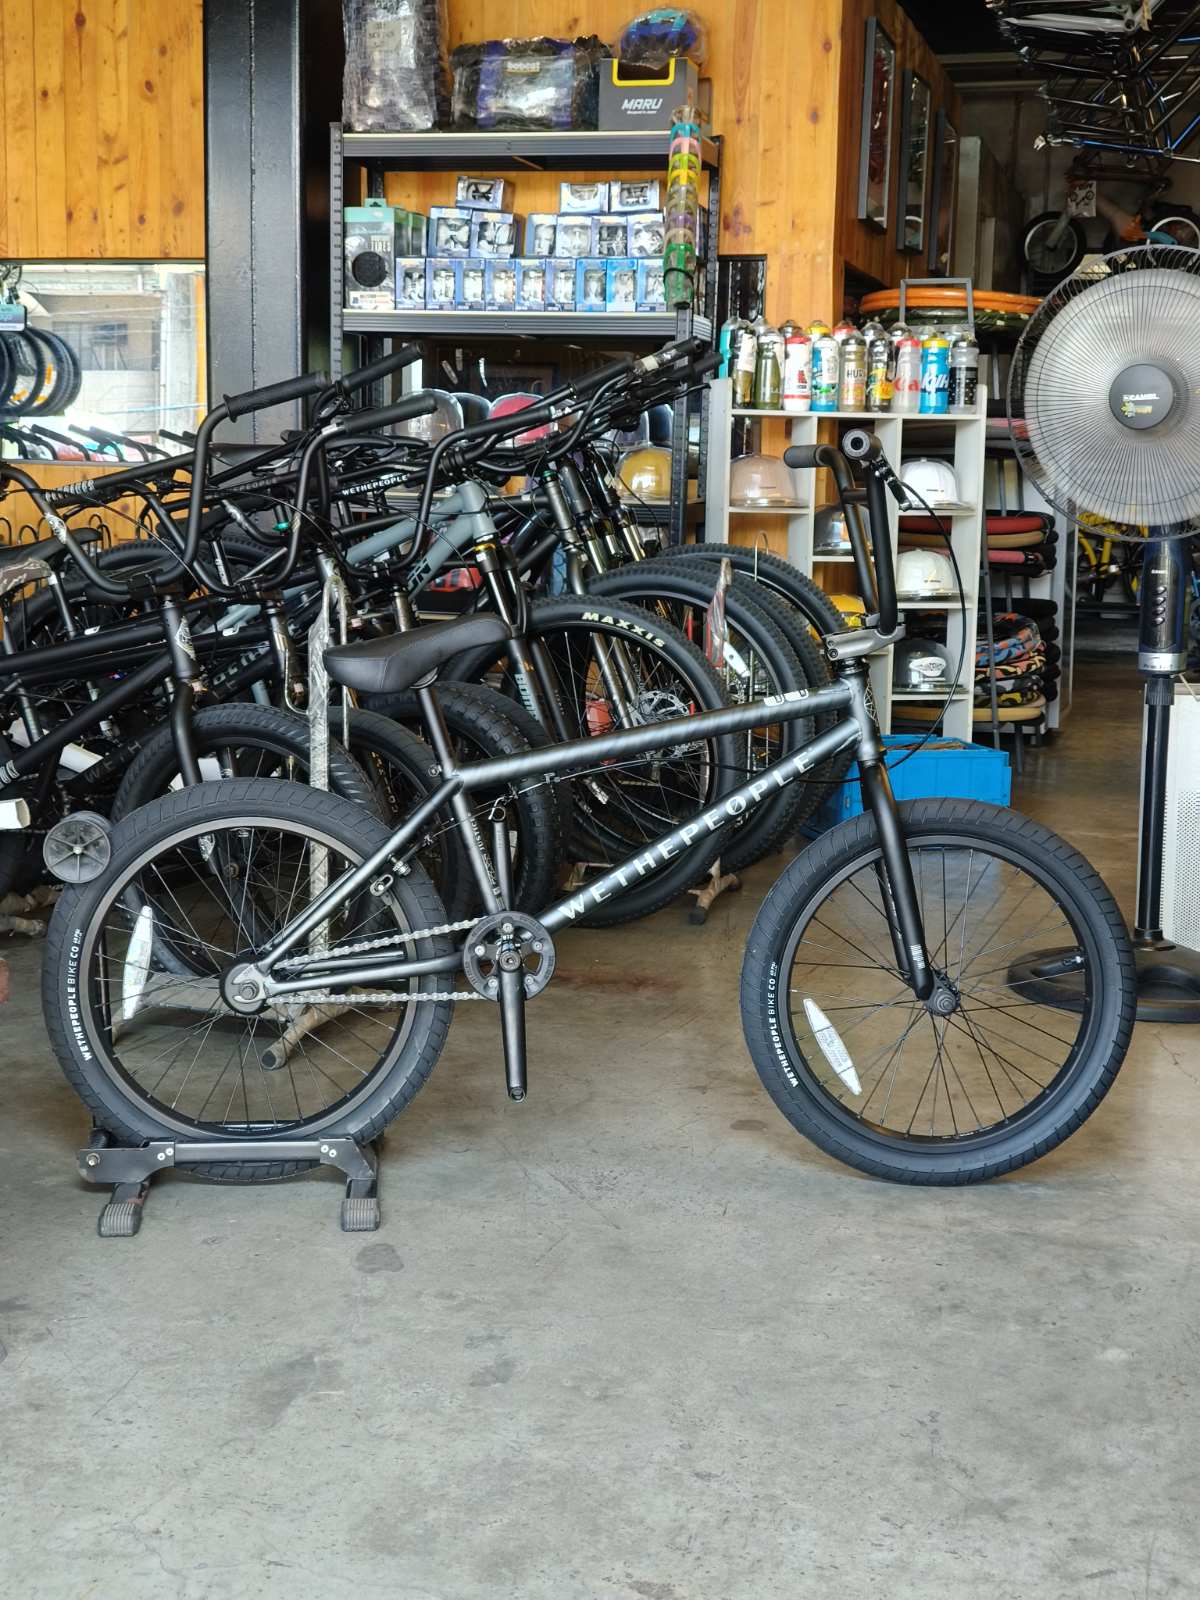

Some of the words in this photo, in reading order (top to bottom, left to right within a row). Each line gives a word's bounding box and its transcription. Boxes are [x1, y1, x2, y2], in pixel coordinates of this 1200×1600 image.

[621, 98, 663, 110] MARU
[341, 474, 409, 496] WETHEPEOPLE
[581, 611, 667, 648] MAXXIS
[558, 751, 815, 920] WETHEPEOPLE
[72, 946, 80, 959] CO
[67, 959, 78, 985] BIKE
[768, 977, 776, 990] CO
[767, 992, 776, 1015] BIKE
[67, 986, 93, 1061] WETHEPEOPLE
[768, 1017, 799, 1088] WETHEPEOPLE
